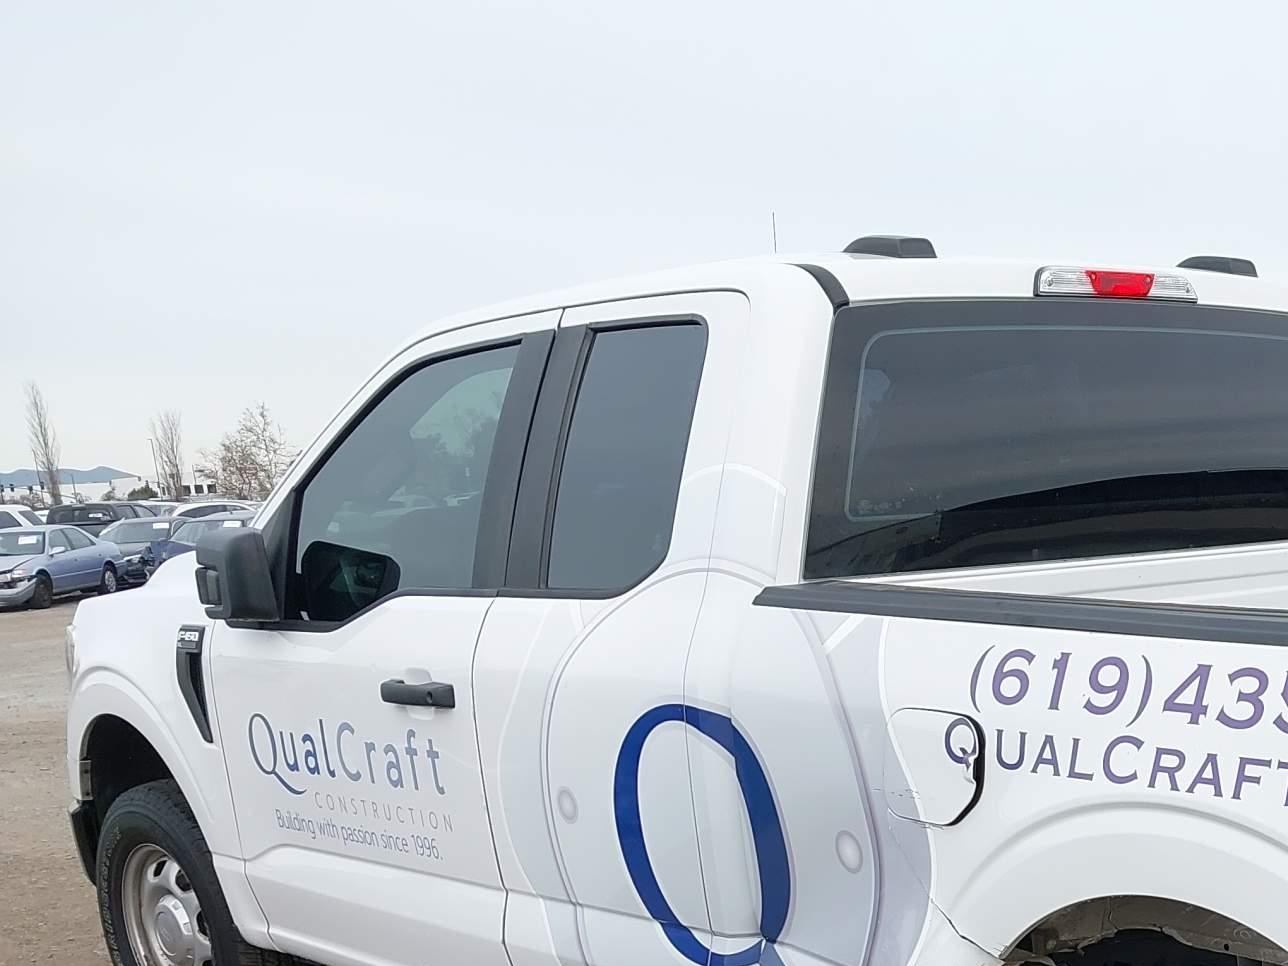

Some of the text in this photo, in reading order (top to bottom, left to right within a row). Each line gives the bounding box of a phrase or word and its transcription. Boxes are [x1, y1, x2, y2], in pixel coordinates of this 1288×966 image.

[248, 713, 445, 795] QualCraft
[275, 808, 444, 861] Building with passion since 1996.
[314, 791, 453, 832] CONSTRUCTION
